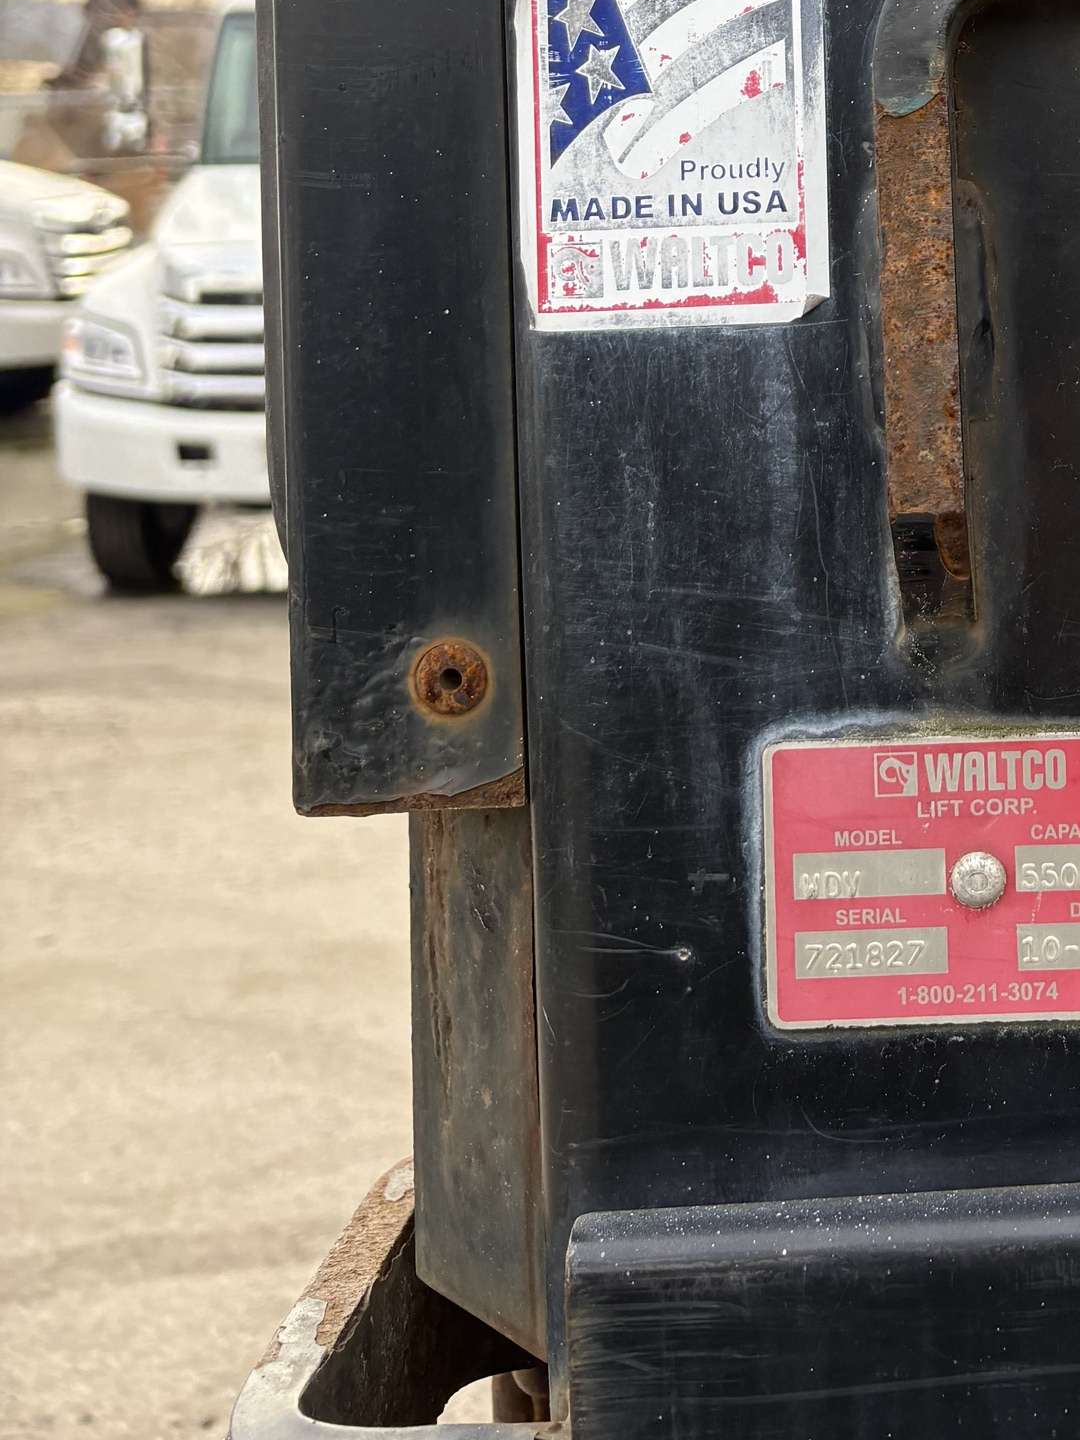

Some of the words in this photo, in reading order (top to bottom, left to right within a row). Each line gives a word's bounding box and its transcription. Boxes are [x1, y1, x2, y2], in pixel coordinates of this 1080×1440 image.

[680, 157, 785, 183] Proudly
[550, 195, 653, 223] MADE
[668, 192, 703, 217] IN
[718, 189, 788, 215] USA
[608, 231, 794, 292] WALTCO
[924, 749, 1067, 793] WALTCO
[917, 800, 960, 819] LIFT
[969, 798, 1037, 816] CORP.
[834, 829, 903, 847] MODEL
[836, 907, 907, 927] SERIAL
[803, 939, 928, 972] 721827
[897, 981, 1059, 1006] 1-800-211-3074
